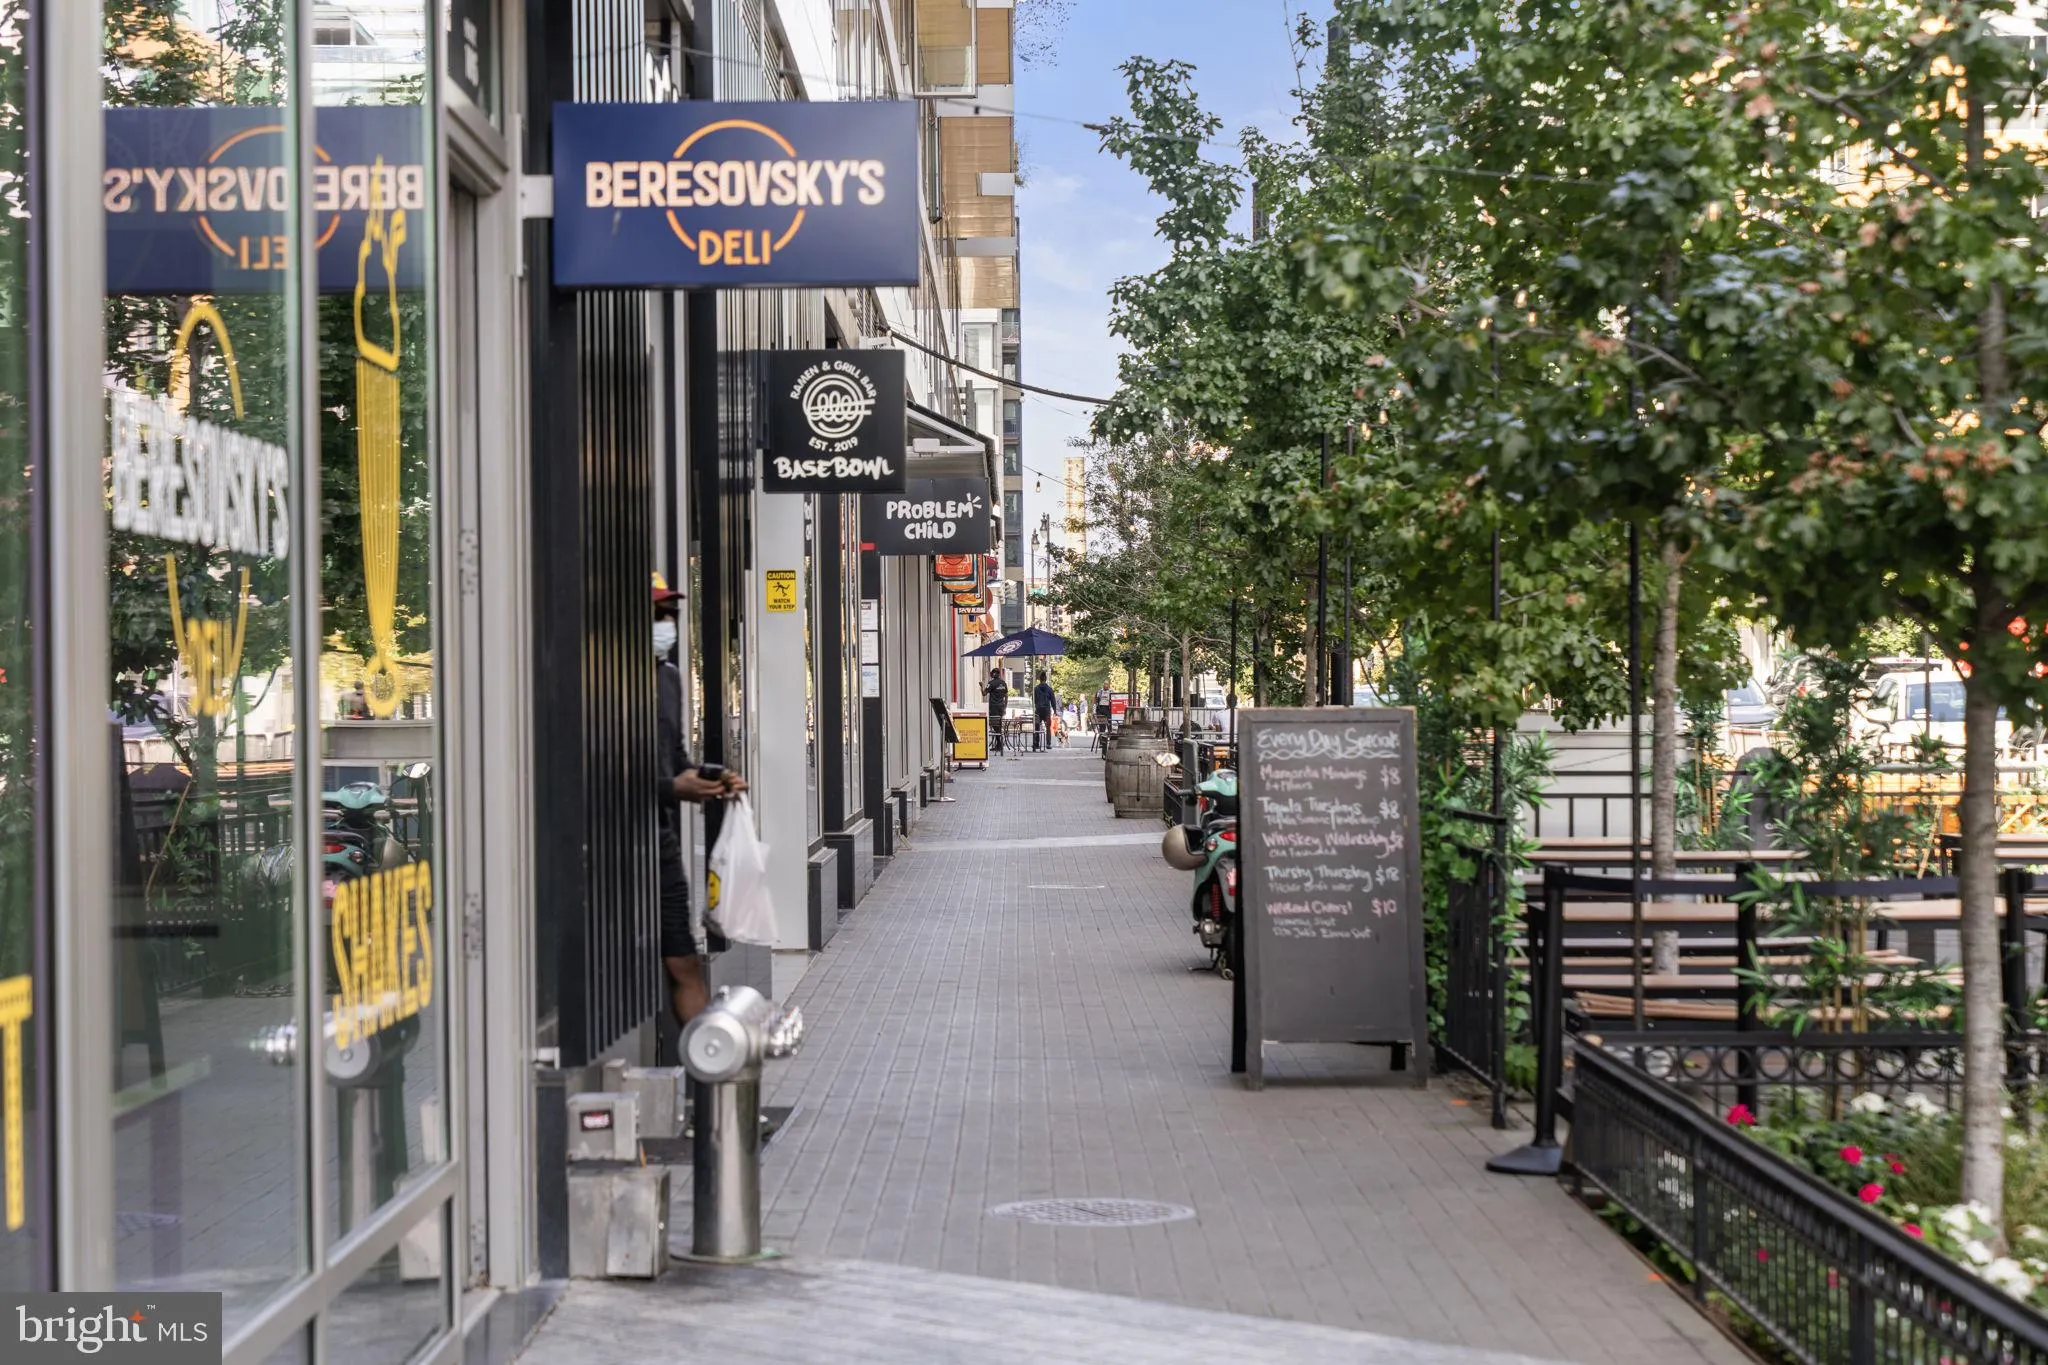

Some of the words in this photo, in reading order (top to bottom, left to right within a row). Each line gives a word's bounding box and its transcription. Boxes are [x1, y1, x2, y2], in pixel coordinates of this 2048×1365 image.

[585, 159, 885, 208] BERESOVSKY'S
[698, 229, 771, 265] DELI
[790, 365, 819, 399] RAMEN
[822, 361, 831, 371] &
[834, 361, 861, 378] GRILL
[860, 376, 877, 398] BAR
[834, 437, 858, 452] 2019
[886, 500, 973, 519] PROBLEM
[767, 571, 795, 579] CAUTION
[1379, 797, 1400, 819] $8
[1371, 898, 1397, 918] $10
[331, 859, 433, 1049] SHAKES
